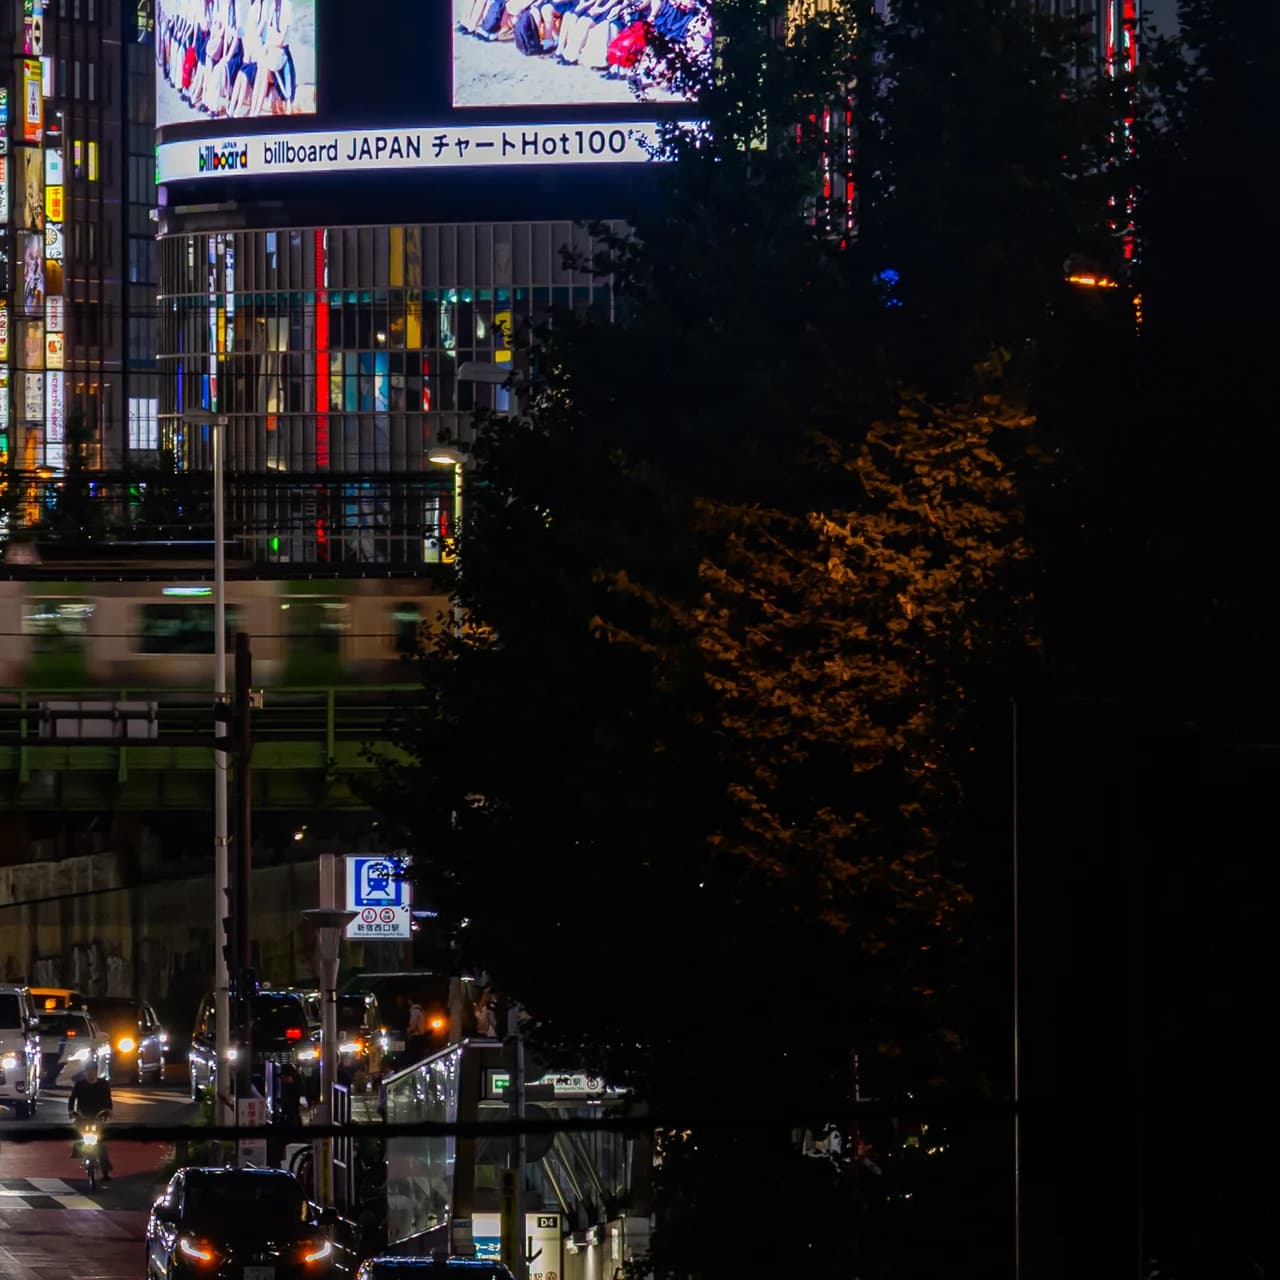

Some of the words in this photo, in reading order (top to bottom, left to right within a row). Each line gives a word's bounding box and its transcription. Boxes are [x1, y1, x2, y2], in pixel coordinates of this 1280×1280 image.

[263, 136, 338, 165] billboard
[347, 134, 421, 161] JAPAN
[540, 1218, 554, 1227] D4
